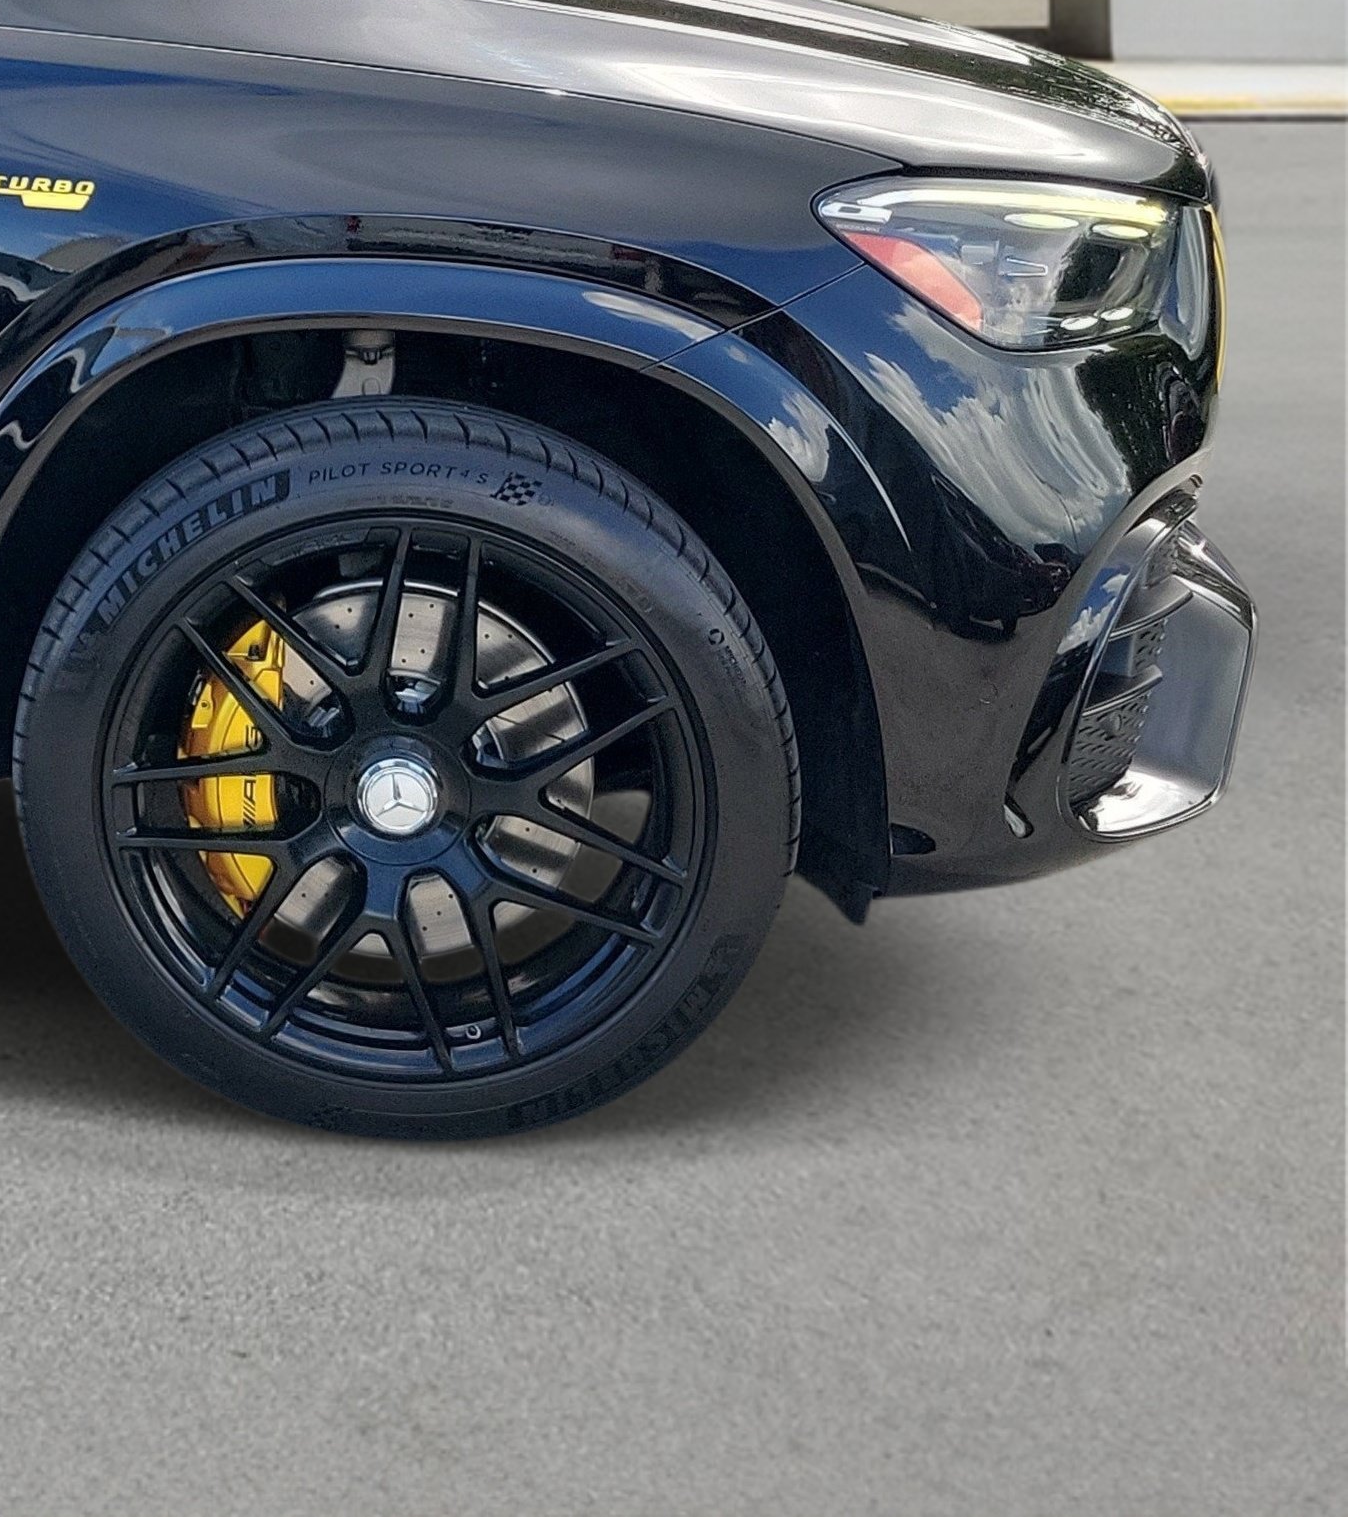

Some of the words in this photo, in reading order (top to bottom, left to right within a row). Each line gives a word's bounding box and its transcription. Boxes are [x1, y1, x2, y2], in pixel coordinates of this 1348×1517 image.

[309, 462, 371, 484] PILOT
[380, 461, 455, 479] SPORT
[476, 472, 490, 484] S
[97, 475, 277, 625] MICHELIN
